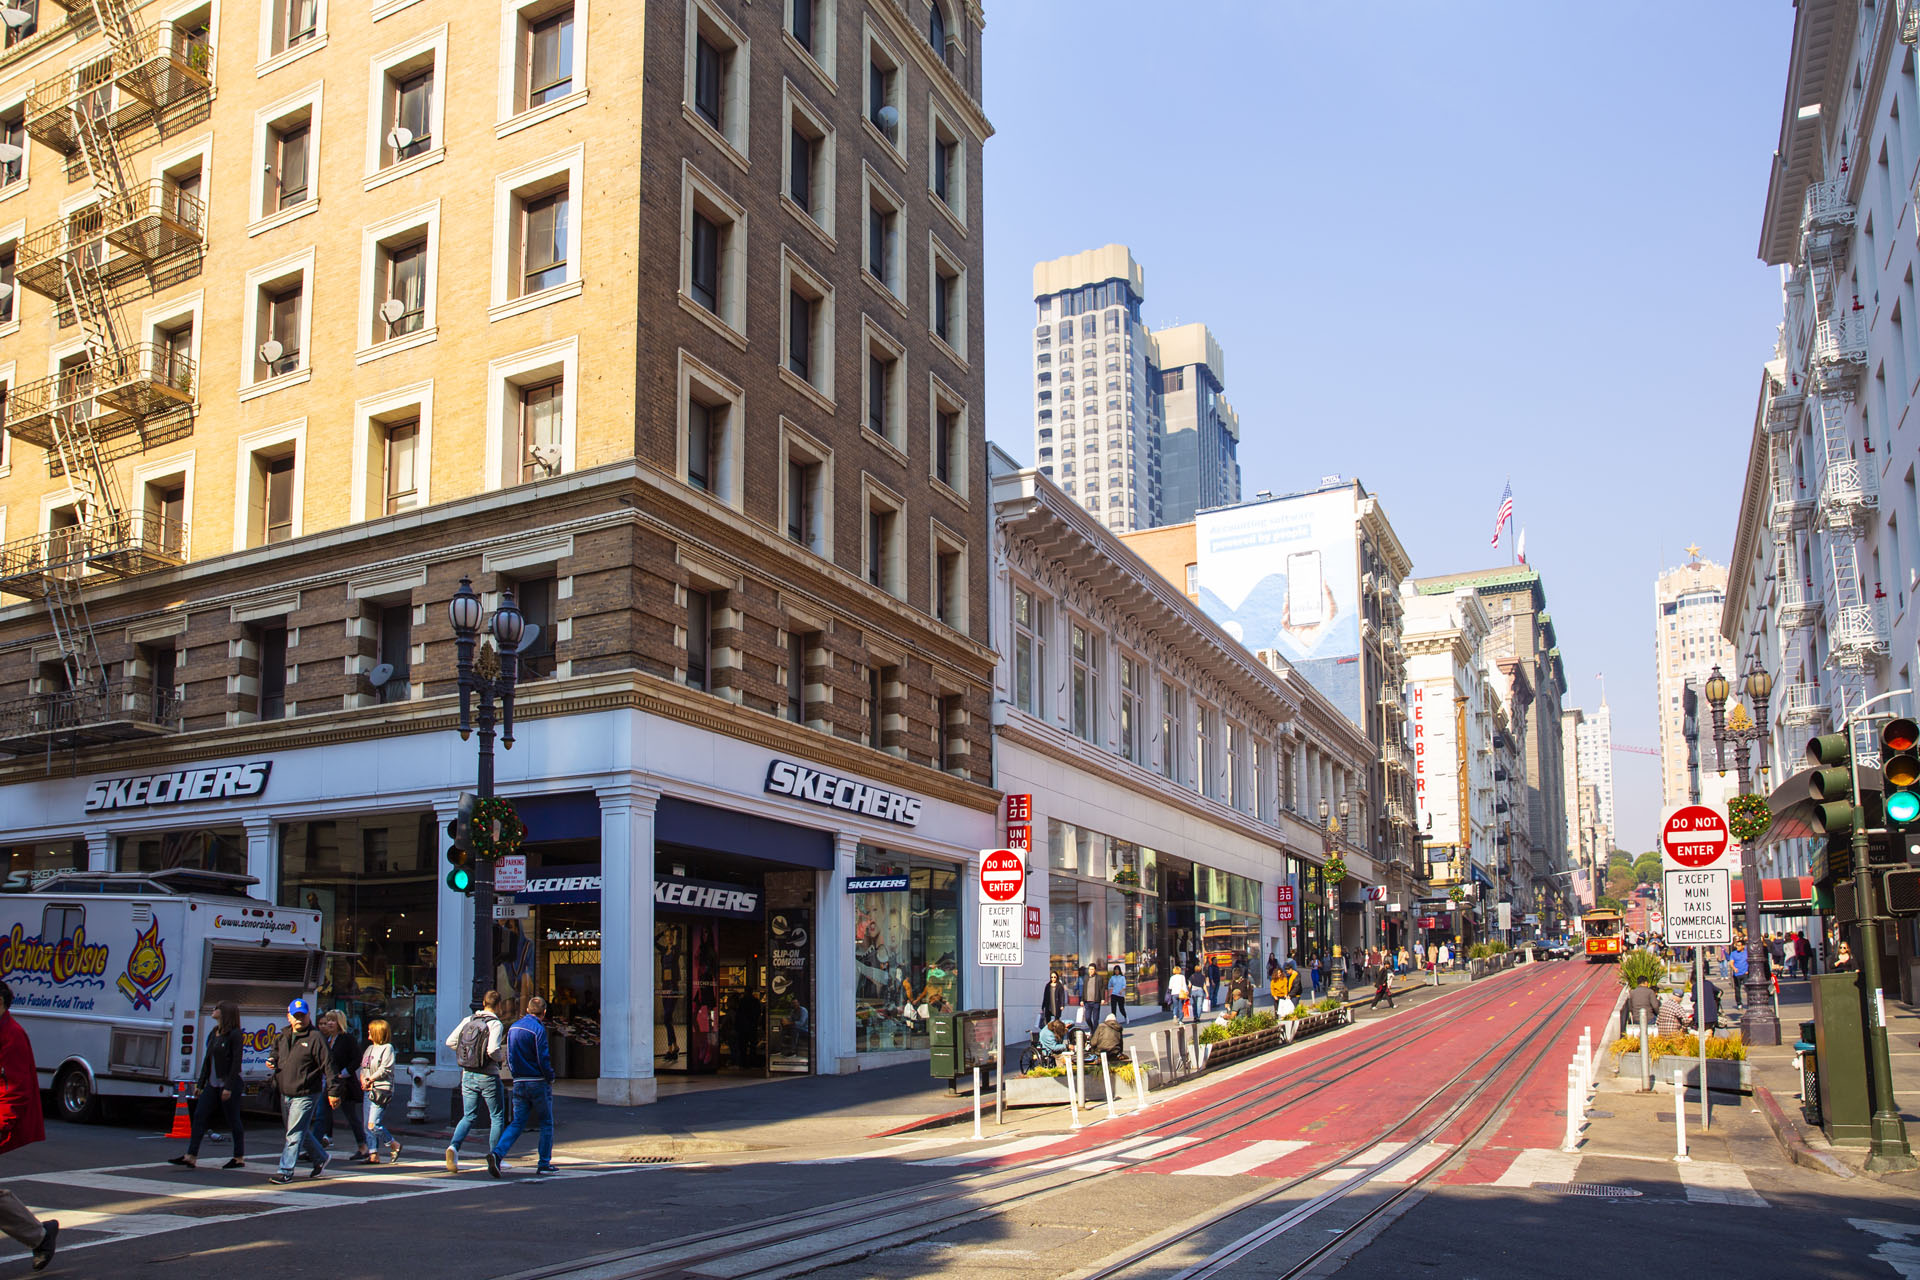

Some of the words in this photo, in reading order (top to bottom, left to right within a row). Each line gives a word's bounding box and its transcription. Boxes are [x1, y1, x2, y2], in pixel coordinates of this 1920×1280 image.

[1414, 688, 1425, 809] HERBERT
[85, 762, 269, 811] SKECHERS
[769, 761, 922, 827] SKECHERS
[1672, 818, 1688, 829] DO
[1695, 817, 1718, 828] NOT
[1009, 829, 1026, 839] UNI
[1677, 845, 1714, 856] ENTER
[987, 860, 998, 869] DO
[1002, 859, 1018, 868] NOT
[1678, 873, 1715, 884] EXCEPT
[517, 876, 602, 893] KECHERS
[848, 879, 907, 890] SKECHERS
[989, 883, 1014, 892] ENTER
[654, 880, 758, 913] KECHERS
[1685, 888, 1709, 898] MUNI
[496, 907, 515, 916] Ellis
[989, 907, 1014, 916] EXCEPT
[1684, 901, 1712, 912] TAXIS
[1029, 910, 1039, 922] UNI
[1669, 915, 1727, 926] COMMERCIAL
[221, 917, 292, 932] www.senorsisig.com
[993, 919, 1009, 927] MUNI
[992, 930, 1011, 938] TAXIS
[1029, 923, 1040, 936] QLO
[1675, 929, 1722, 940] VEHICLES
[982, 941, 1020, 950] COMMERCIAL
[772, 950, 800, 959] SLIP-ON
[985, 953, 1017, 962] VEHICLES
[772, 957, 807, 967] COMFORT
[27, 993, 52, 1008] Fusion
[52, 995, 72, 1009] Food
[72, 996, 95, 1010] Truck
